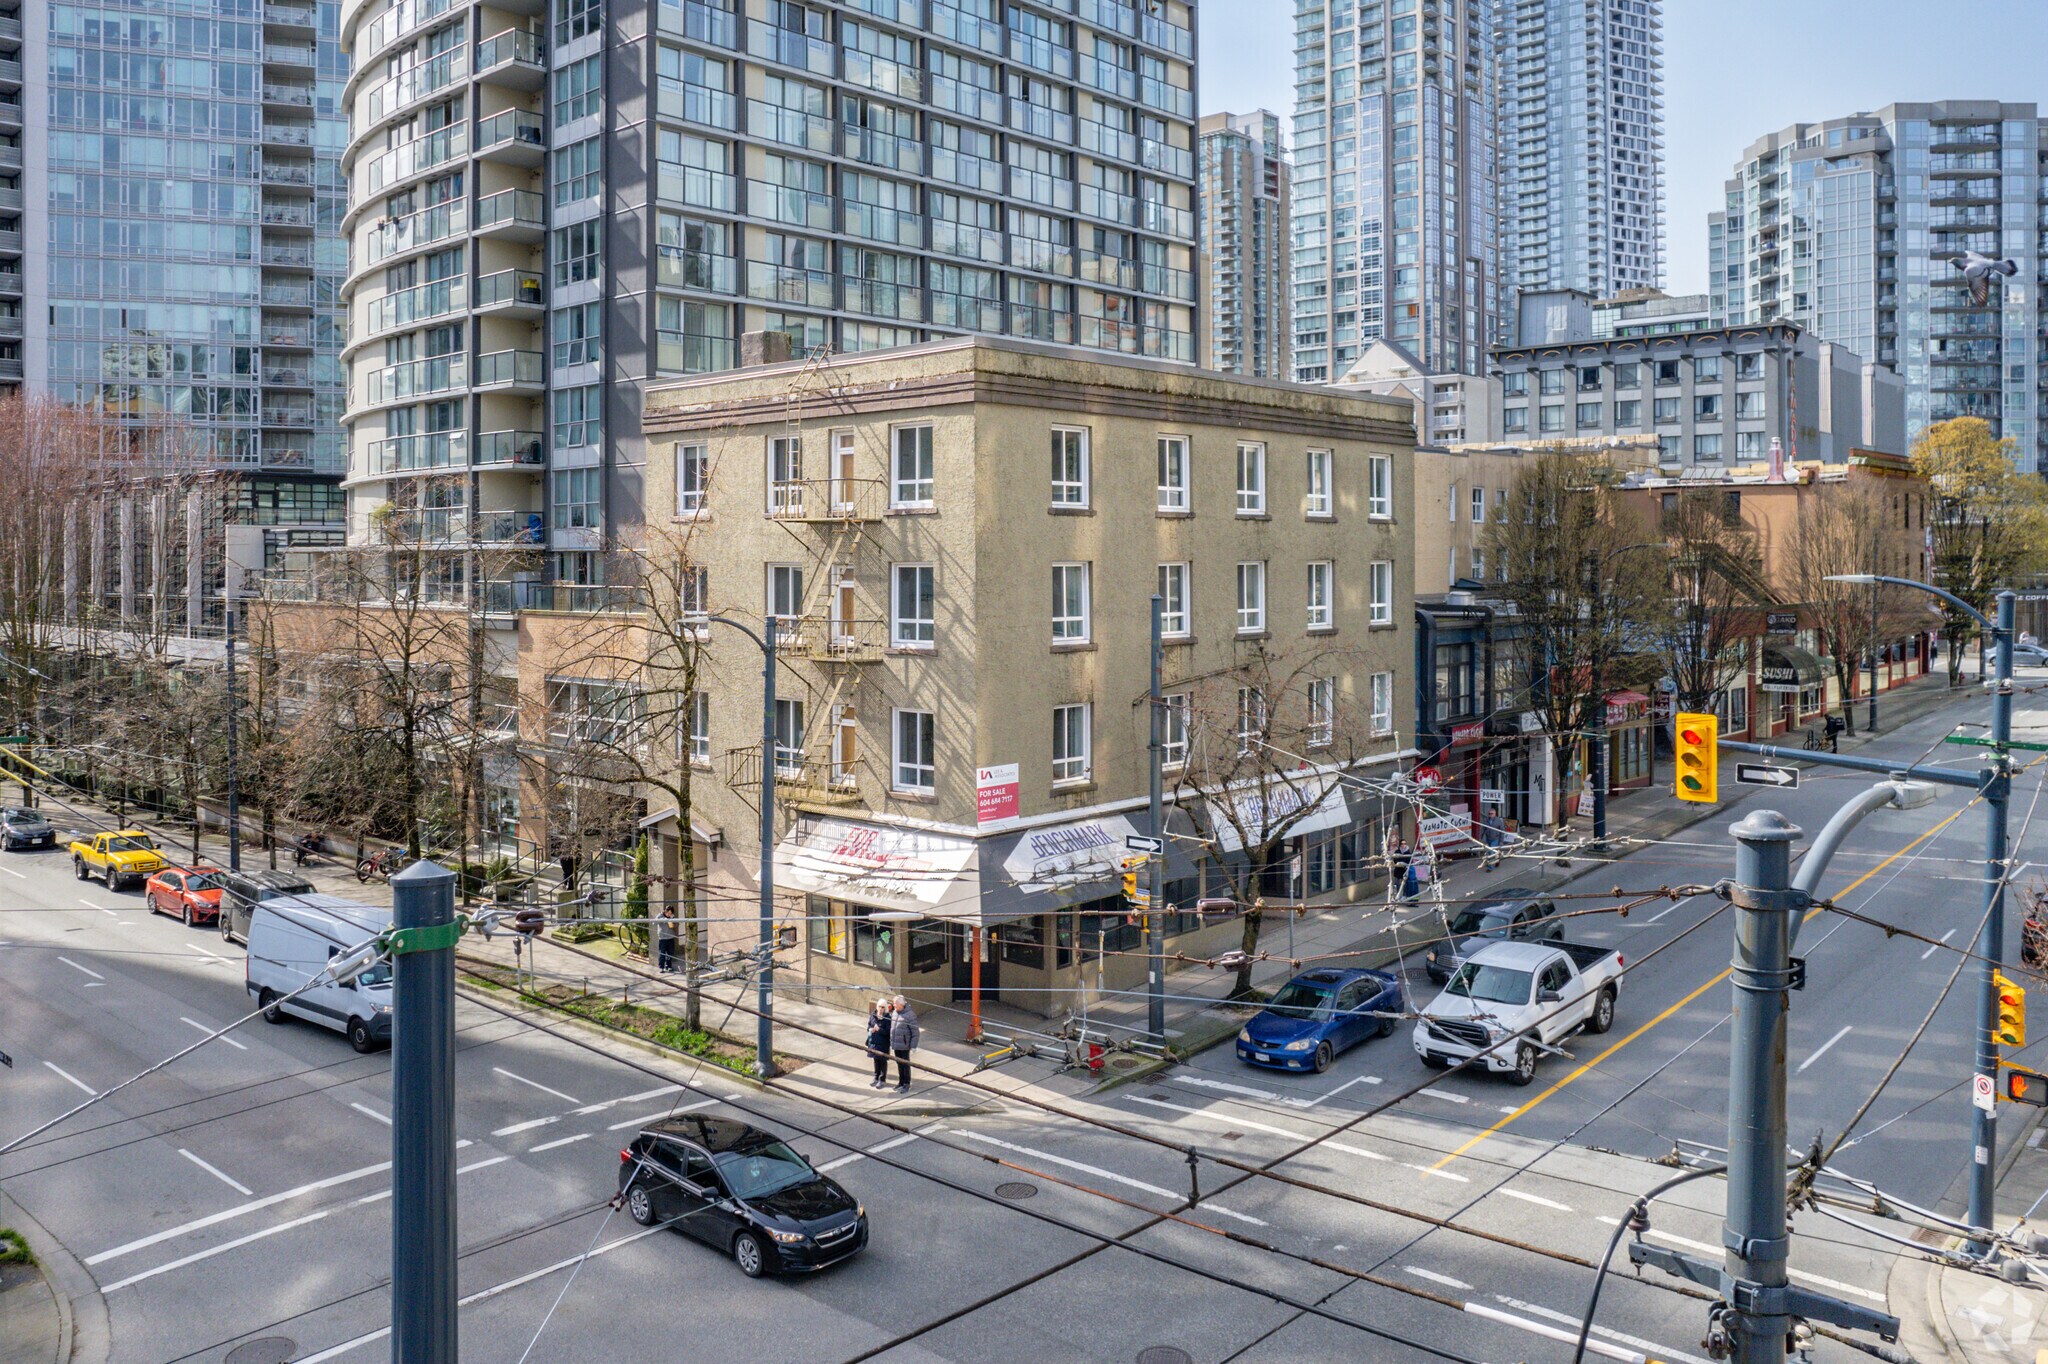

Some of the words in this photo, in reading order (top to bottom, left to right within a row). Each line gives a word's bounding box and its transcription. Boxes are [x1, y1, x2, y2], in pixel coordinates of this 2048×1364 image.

[1763, 667, 1794, 680] SUSHI
[979, 789, 991, 798] FOR
[992, 788, 1006, 796] SALE
[1483, 791, 1501, 799] POWER
[980, 799, 990, 807] 604
[1031, 823, 1114, 858] BENCHMARK
